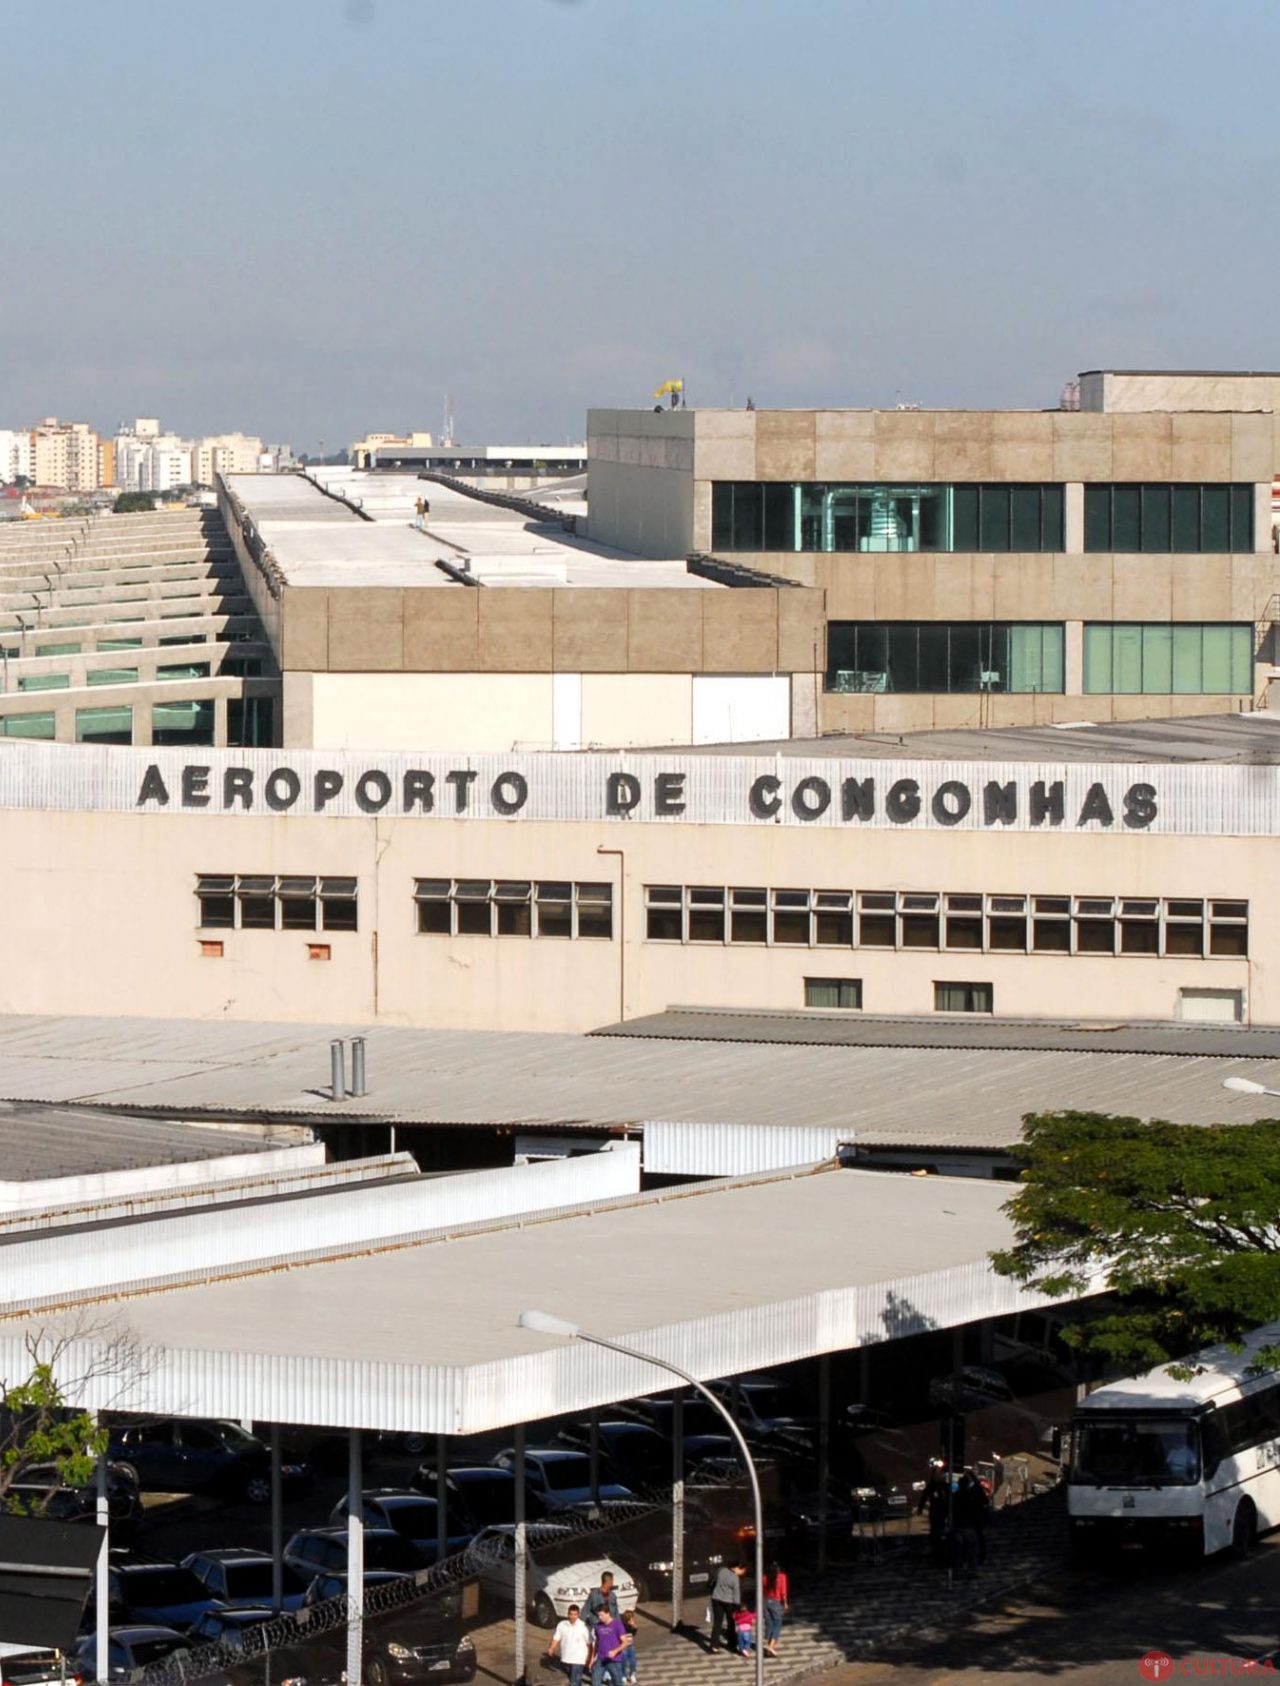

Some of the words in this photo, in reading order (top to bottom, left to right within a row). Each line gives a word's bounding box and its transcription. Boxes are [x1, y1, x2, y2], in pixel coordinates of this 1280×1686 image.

[136, 764, 529, 816] AEROPORTO
[607, 772, 686, 818] DE
[749, 774, 1158, 829] CONGONHAS
